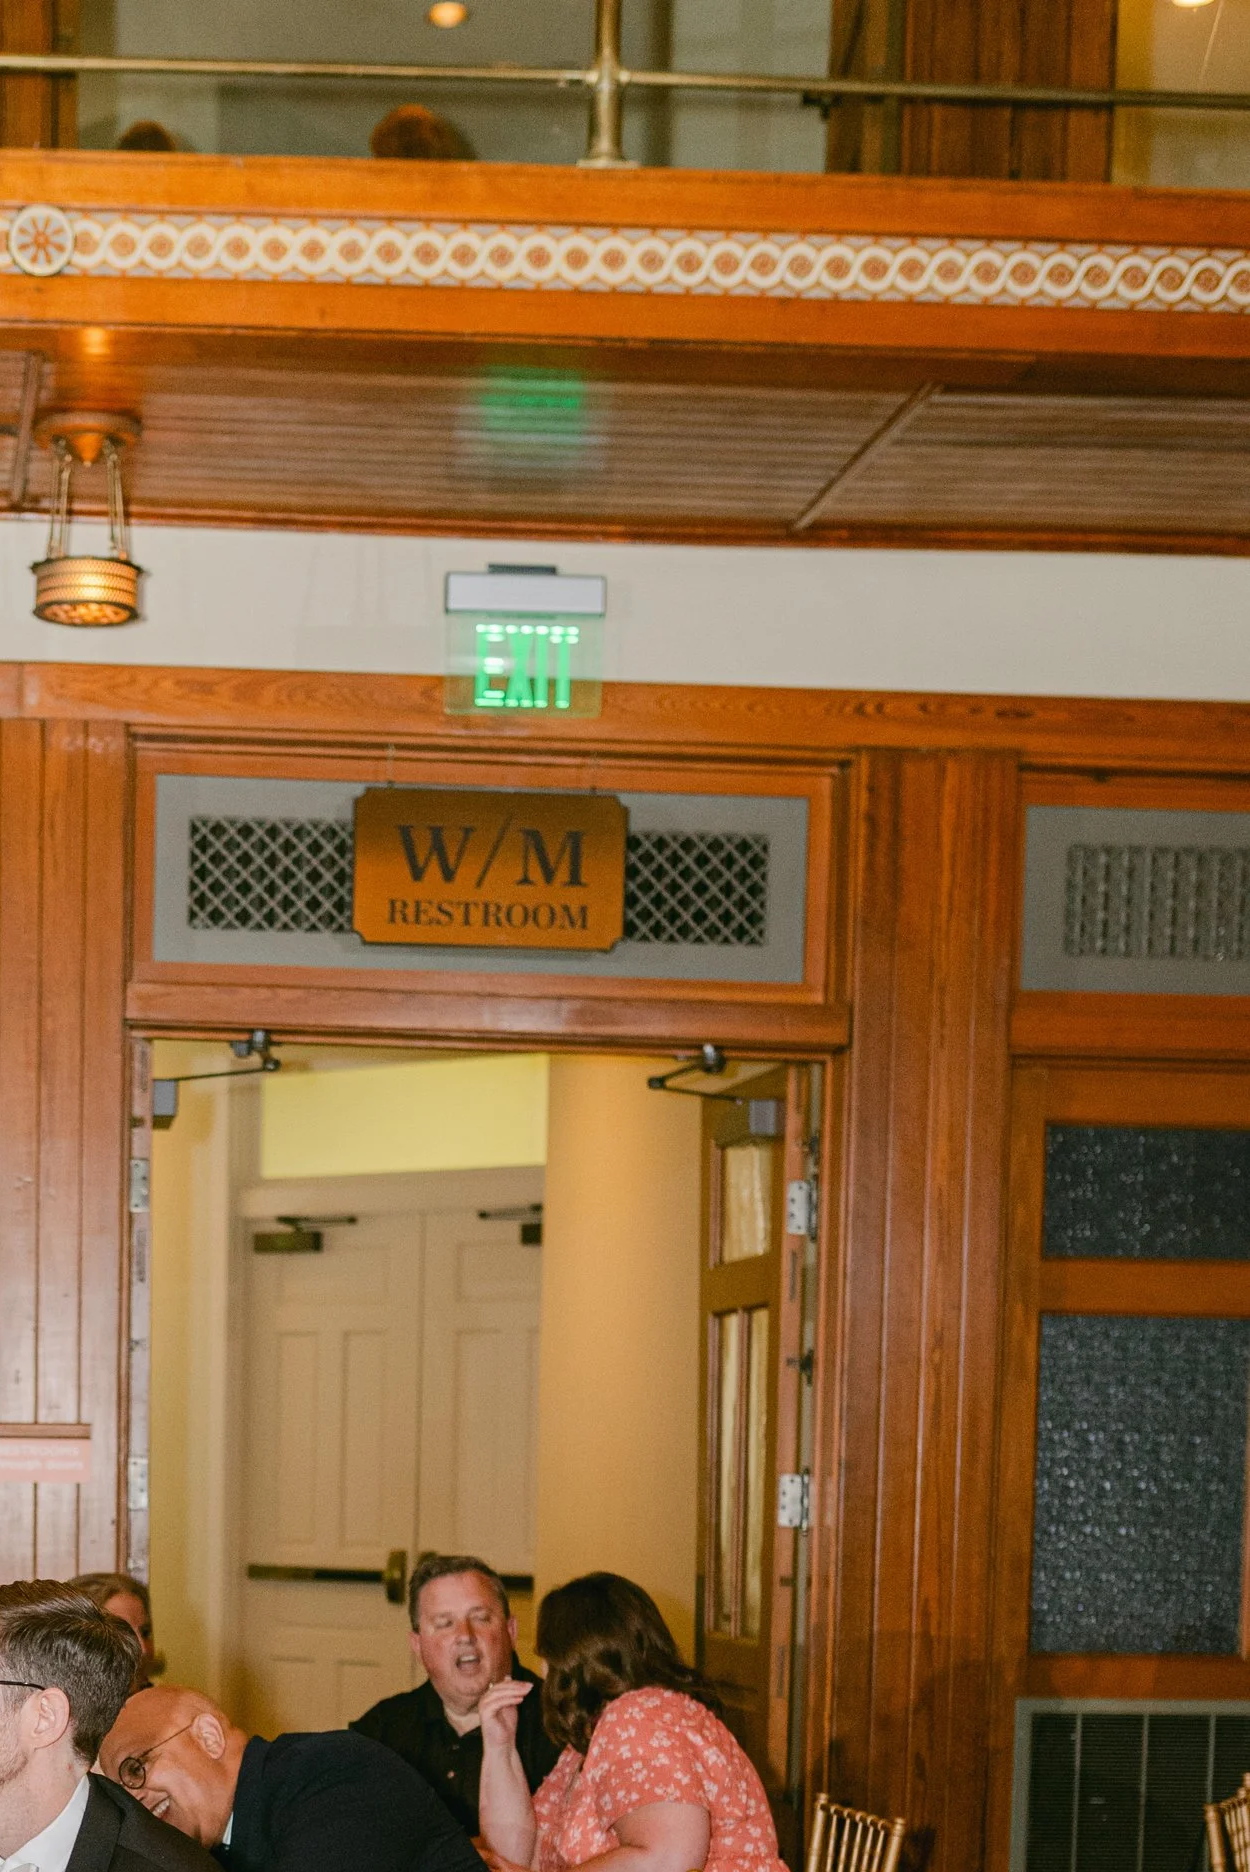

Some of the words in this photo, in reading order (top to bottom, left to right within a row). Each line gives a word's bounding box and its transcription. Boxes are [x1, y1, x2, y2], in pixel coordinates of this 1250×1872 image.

[475, 624, 579, 709] EXIT
[397, 813, 588, 889] W/M
[387, 898, 589, 931] RESTROOM
